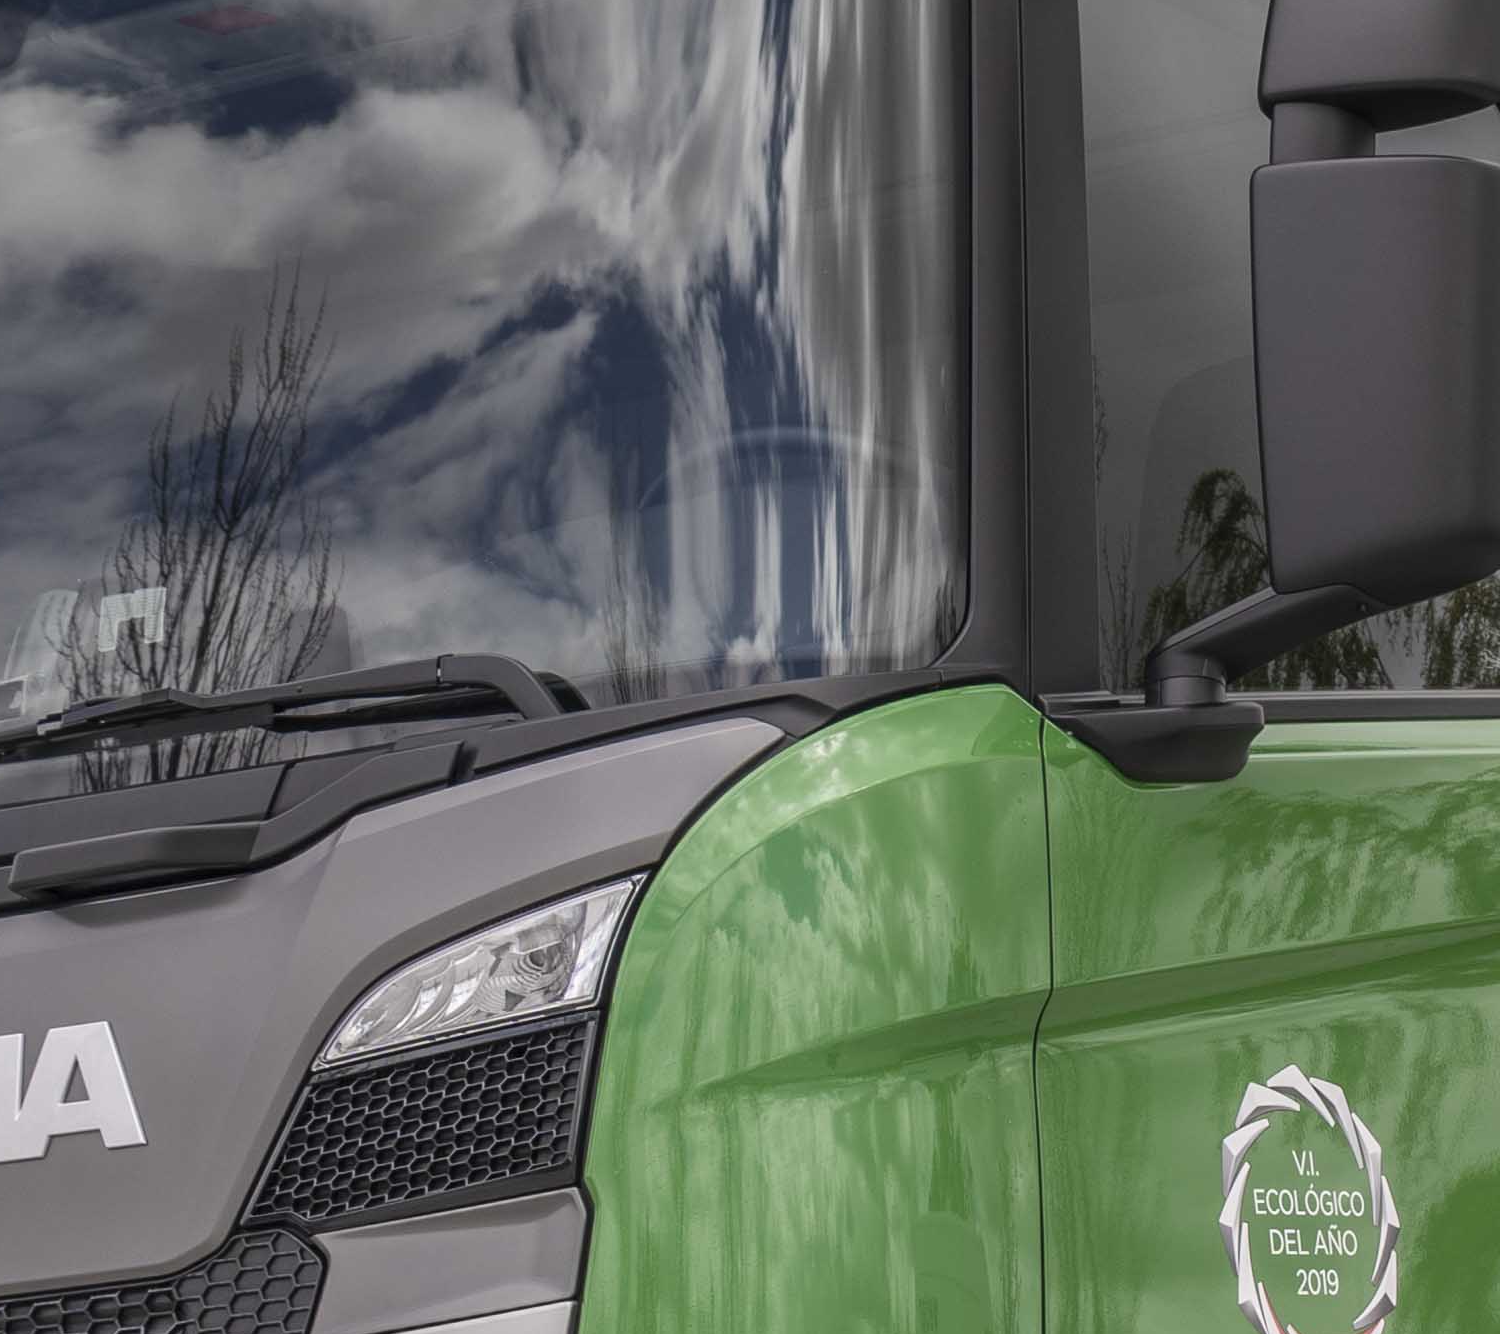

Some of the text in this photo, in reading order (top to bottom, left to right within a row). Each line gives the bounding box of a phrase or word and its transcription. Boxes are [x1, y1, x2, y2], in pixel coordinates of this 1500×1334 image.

[1291, 1149, 1320, 1177] V.I.
[1253, 1183, 1366, 1218] ECOLÓGICO
[1268, 1224, 1359, 1257] DEL AÑO
[1296, 1269, 1340, 1296] 2019
